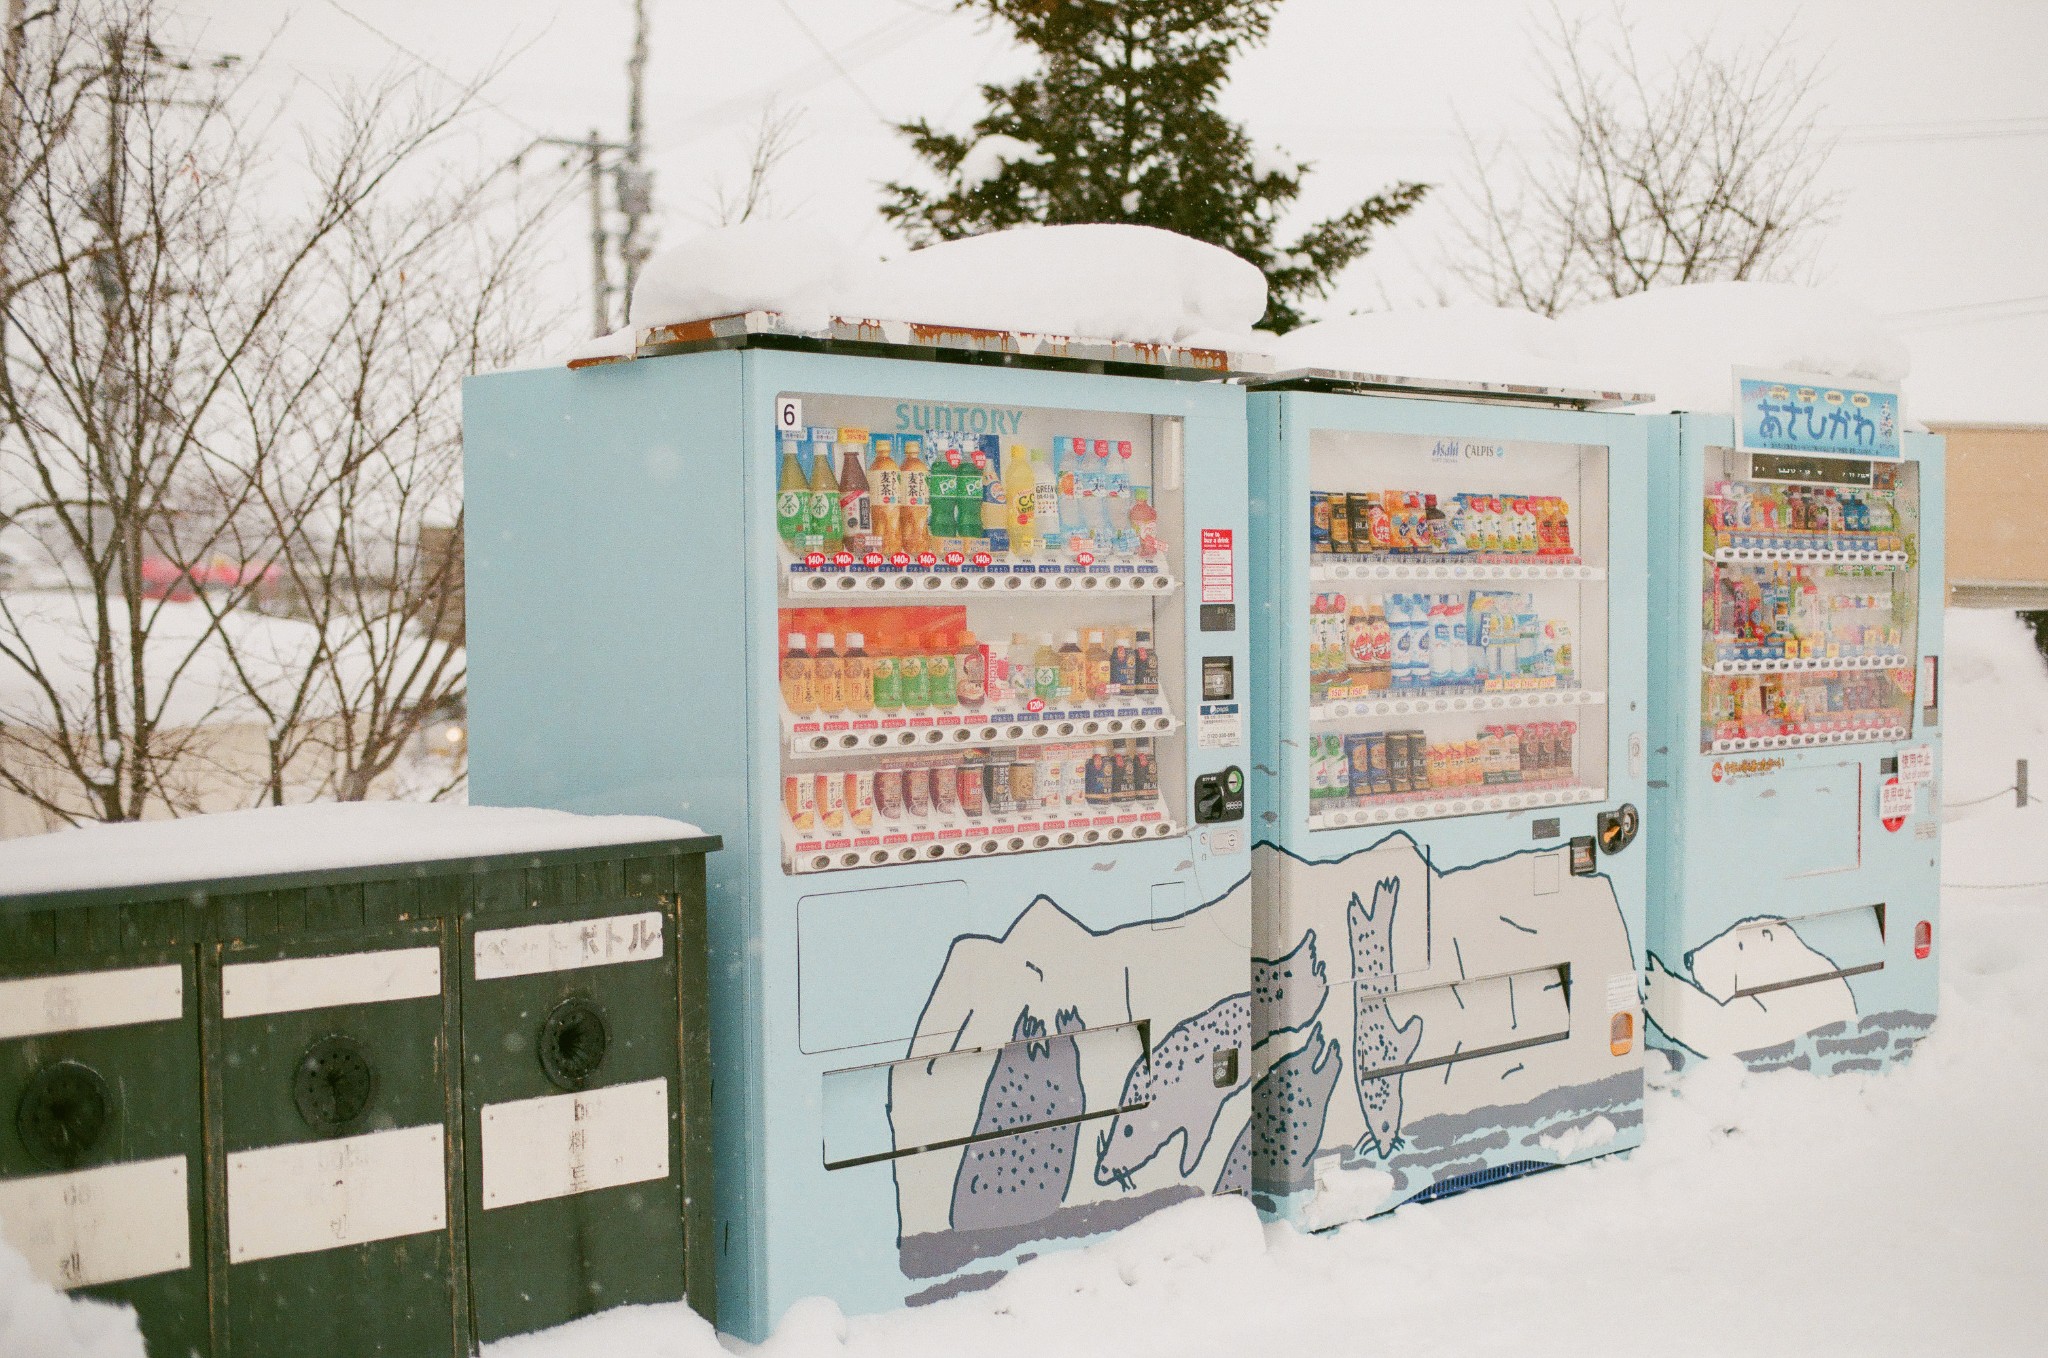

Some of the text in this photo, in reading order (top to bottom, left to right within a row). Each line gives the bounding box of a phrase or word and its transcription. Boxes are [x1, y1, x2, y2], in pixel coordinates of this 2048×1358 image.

[784, 404, 795, 426] 6
[896, 402, 1022, 435] SUNTORY
[1757, 398, 1876, 447] あさひかわ
[1432, 440, 1494, 459] Asahi CALPIS
[881, 471, 891, 496] 麦茶
[908, 472, 918, 496] 麦茶
[1035, 485, 1054, 494] GREEN
